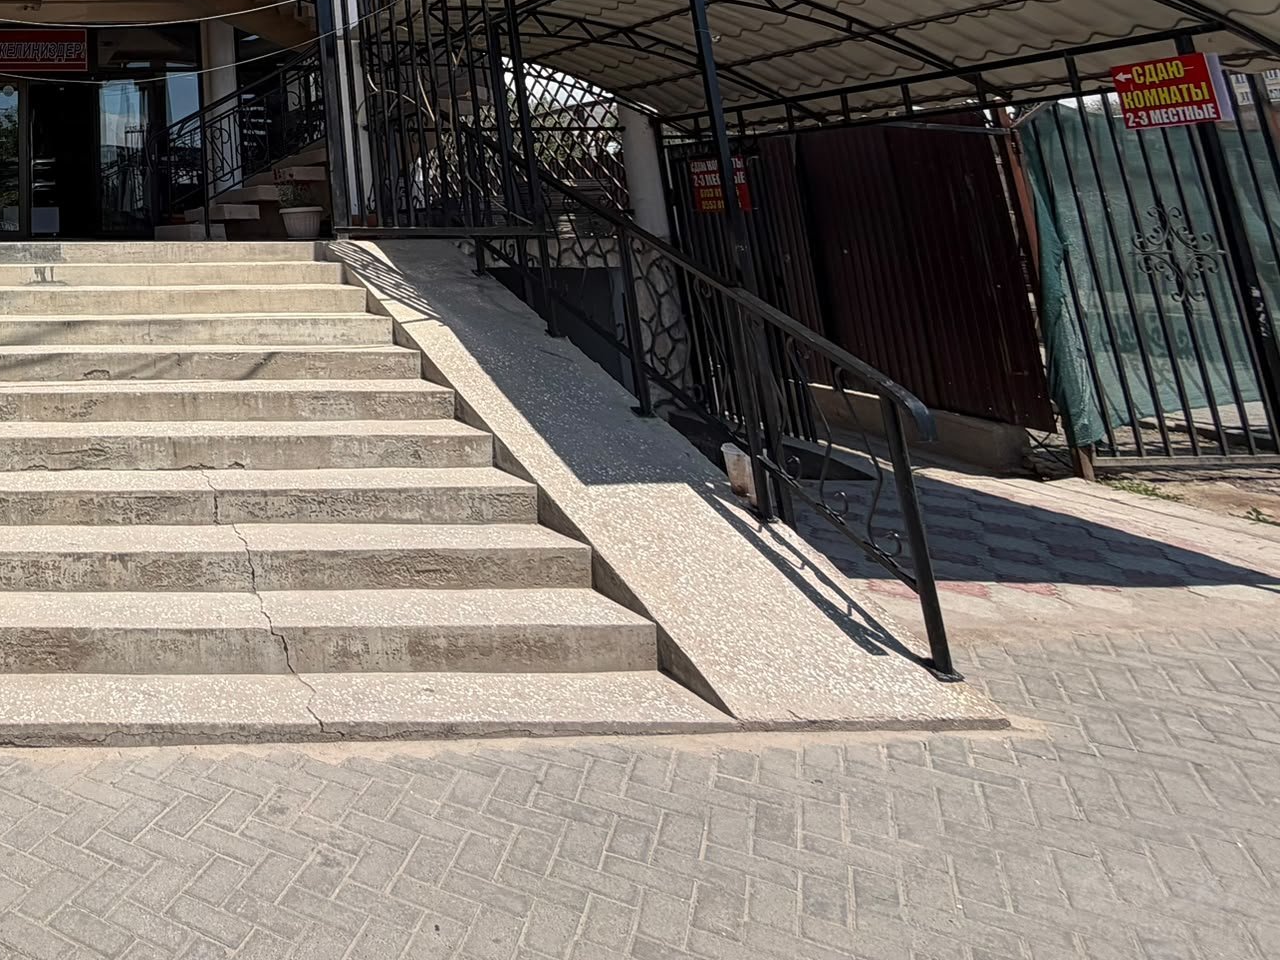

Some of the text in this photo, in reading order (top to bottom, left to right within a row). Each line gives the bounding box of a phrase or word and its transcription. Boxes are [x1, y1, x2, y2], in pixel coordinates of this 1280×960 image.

[1131, 60, 1185, 85] СДАЮ
[1122, 82, 1210, 109] КОМНАТЫ
[1125, 103, 1217, 127] 2-3 МЕСТНЫЕ
